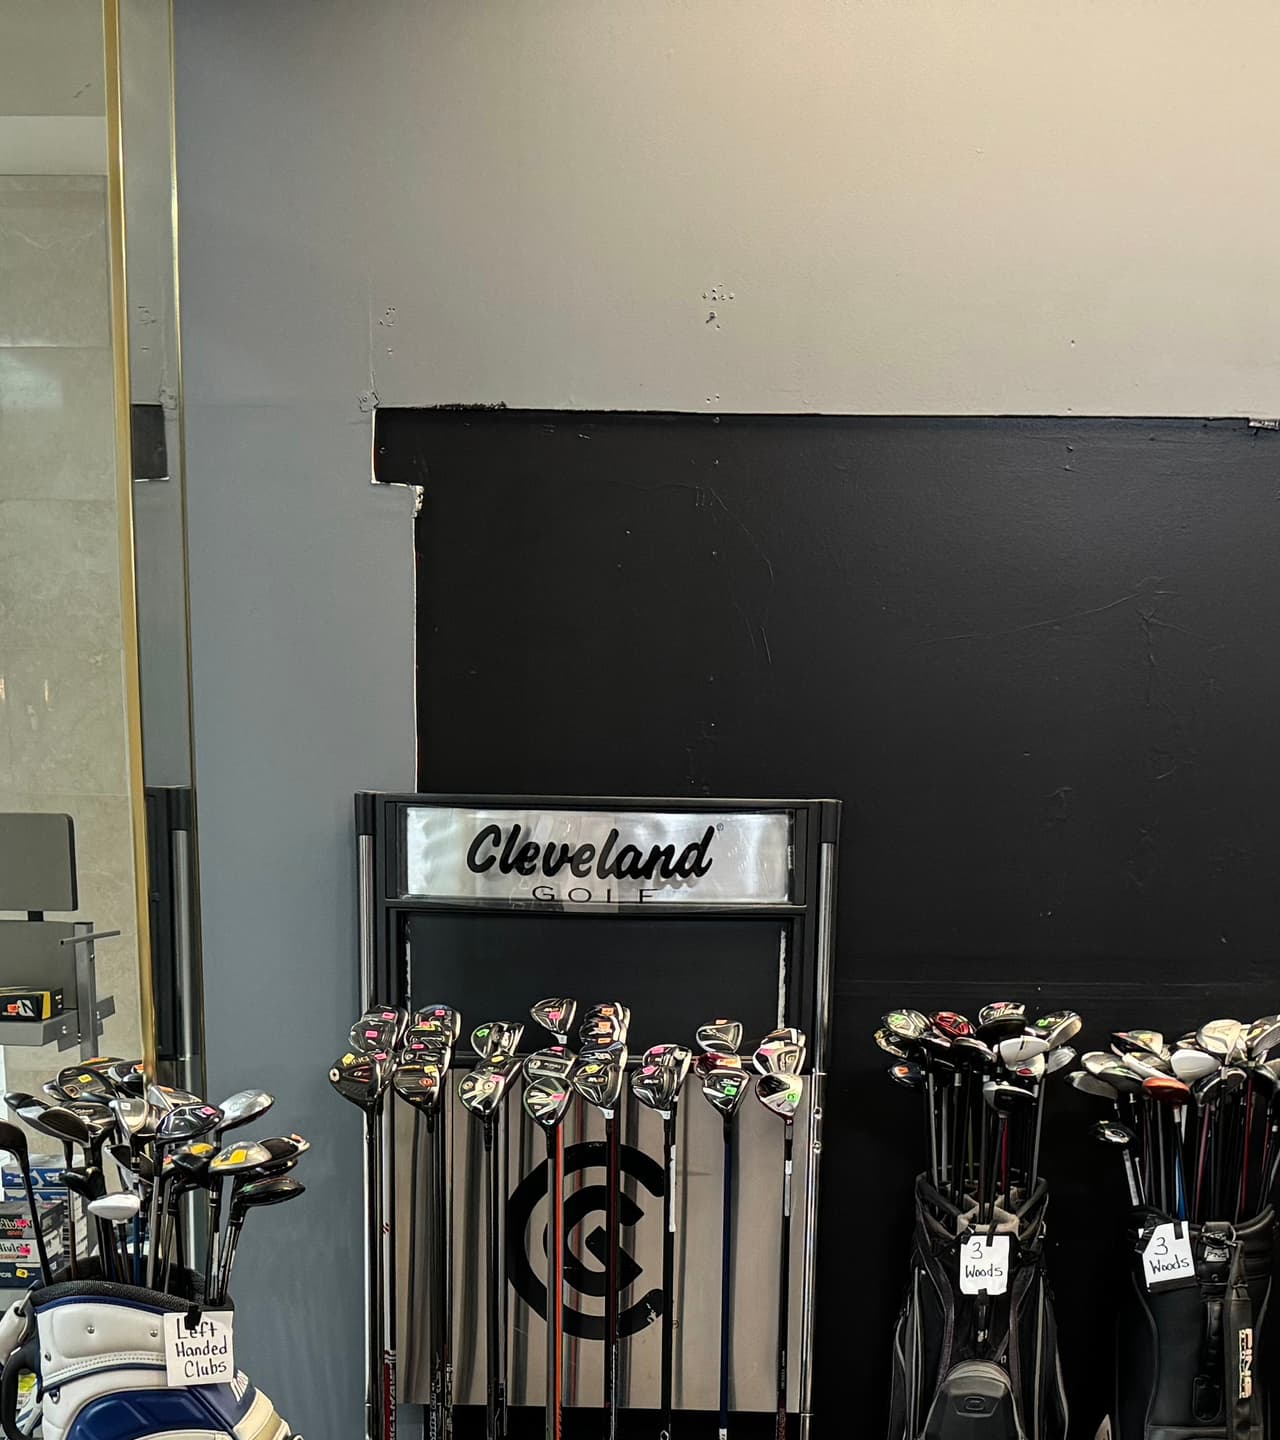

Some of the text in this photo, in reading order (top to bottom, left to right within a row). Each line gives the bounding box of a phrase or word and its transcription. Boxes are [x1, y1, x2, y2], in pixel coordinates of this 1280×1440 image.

[466, 822, 716, 881] Cleveland
[970, 1241, 984, 1260] 3
[1153, 1236, 1169, 1256] 3
[965, 1263, 1004, 1279] Woods
[1149, 1254, 1190, 1275] Woods
[177, 1318, 218, 1340] Left
[176, 1335, 228, 1358] Handed
[184, 1357, 228, 1378] Clubs
